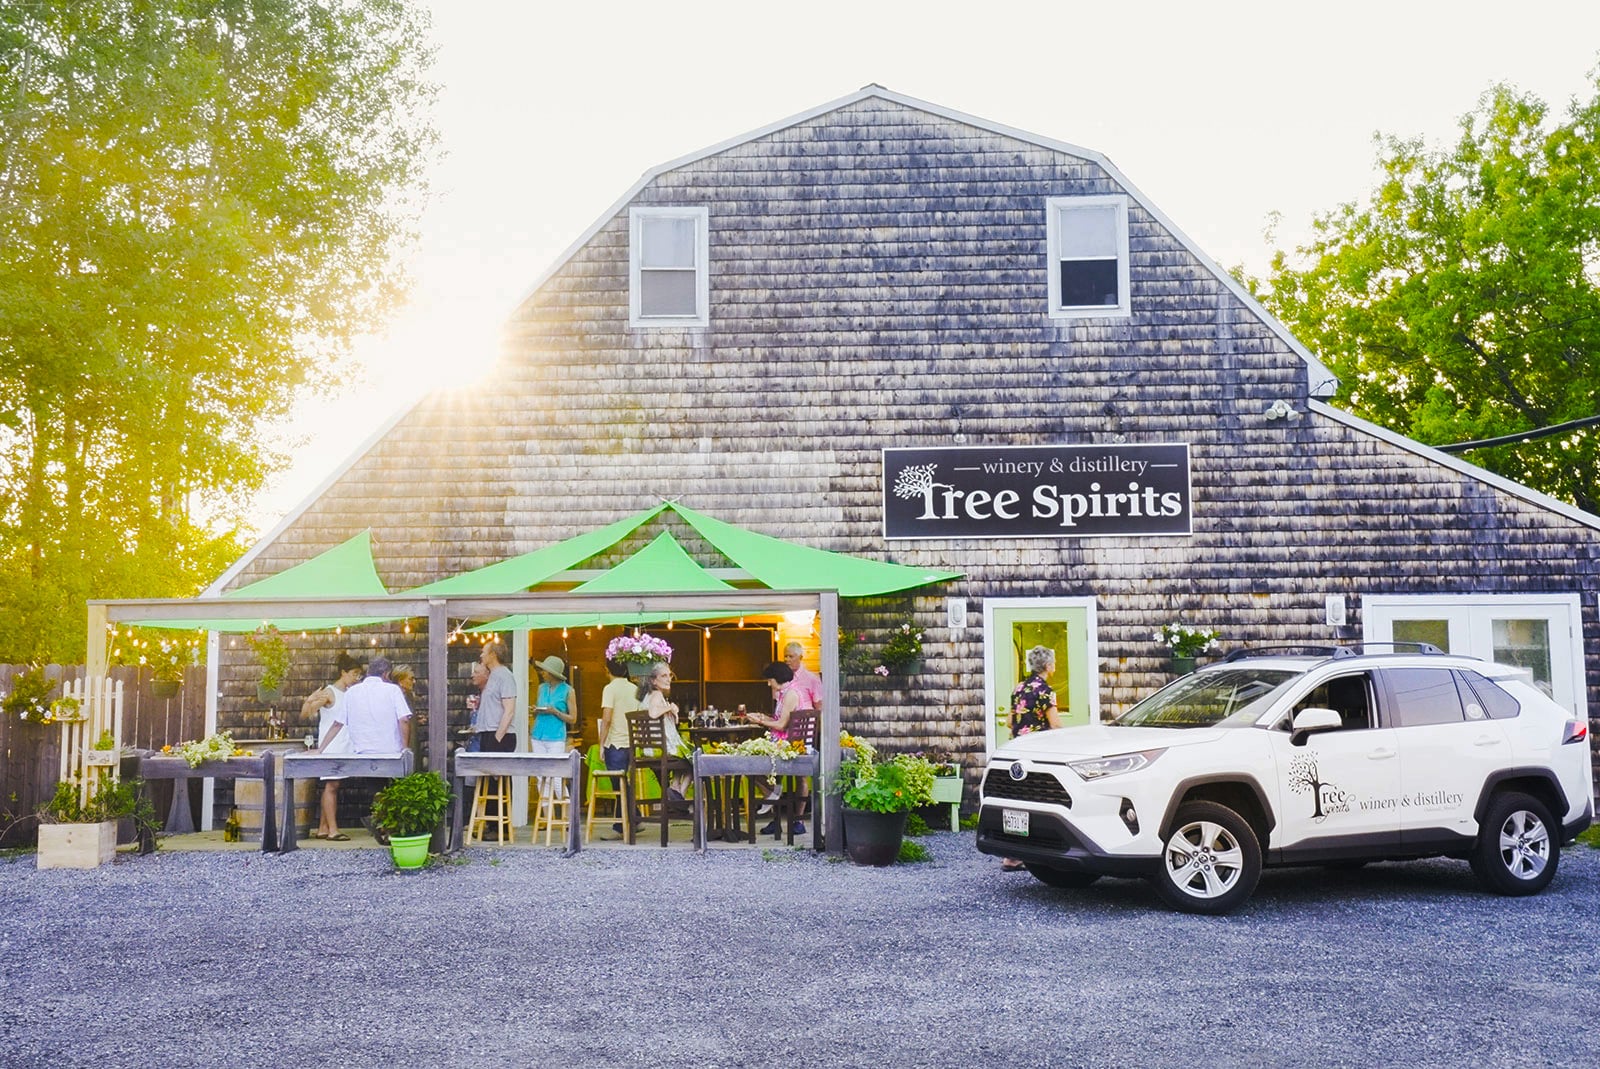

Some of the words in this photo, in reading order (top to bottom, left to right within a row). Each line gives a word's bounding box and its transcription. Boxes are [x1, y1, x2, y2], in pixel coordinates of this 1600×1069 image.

[983, 459, 1044, 478] winery
[1049, 458, 1064, 473] &
[1069, 456, 1148, 476] distillery
[900, 472, 1020, 520] Tree
[1032, 482, 1182, 527] Spirits
[1359, 796, 1399, 812] winery
[1401, 795, 1410, 808] &
[1413, 791, 1464, 807] distillery
